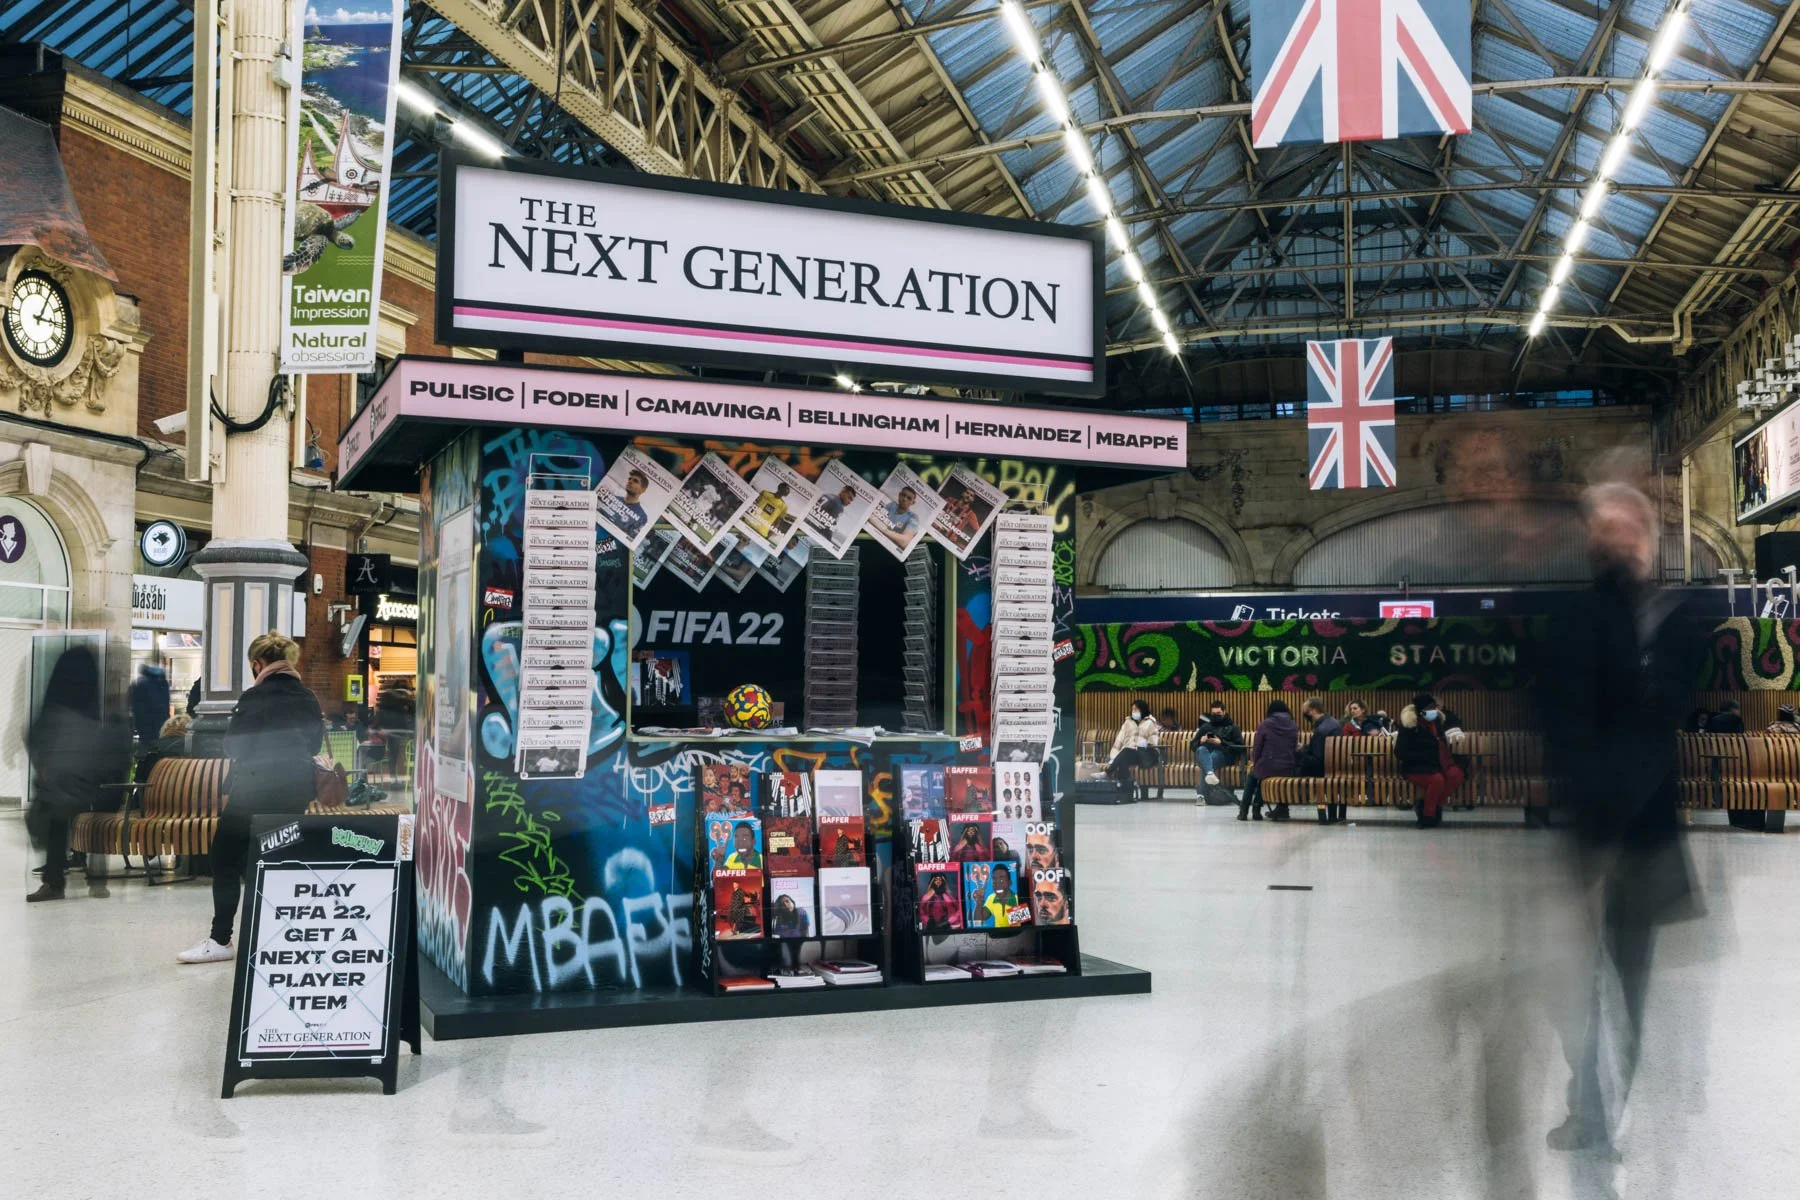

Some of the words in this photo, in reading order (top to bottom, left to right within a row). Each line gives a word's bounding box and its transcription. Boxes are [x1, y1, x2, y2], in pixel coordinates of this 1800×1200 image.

[520, 197, 597, 227] THE
[488, 222, 668, 284] NEXT
[683, 246, 1060, 324] GENERATION
[293, 284, 370, 304] Taiwan
[293, 306, 368, 321] Impression
[292, 332, 366, 348] Natural
[292, 350, 364, 361] obsession
[410, 380, 514, 402] PULISIC
[533, 390, 618, 410] FODEN
[636, 397, 782, 422] CAMAVINGA
[798, 409, 940, 433] BELLINGHAM
[956, 422, 1082, 444] HERNÁNDEZ
[1096, 432, 1178, 450] MBAPPÉ
[638, 462, 674, 490] GENERATION
[716, 470, 751, 500] GENERATION
[780, 472, 814, 499] GENERATION
[842, 475, 876, 502] GENERATION
[908, 480, 939, 508] GENERATION
[966, 479, 999, 504] GENERATION
[597, 487, 642, 521] CHRISTIAN
[356, 556, 378, 584] A
[132, 588, 166, 610] wasabi
[1266, 608, 1341, 619] Tickets
[646, 610, 732, 644] FIFA
[736, 612, 784, 644] 22
[1218, 645, 1348, 667] VICTORIA
[1390, 643, 1516, 666] STATION
[260, 824, 300, 852] PULISIC
[1026, 824, 1054, 835] OOF
[1034, 870, 1064, 882] OOF
[294, 884, 356, 897] PLAY
[275, 906, 327, 920] FIFA
[333, 906, 371, 921] 22,
[284, 928, 335, 942] GET
[340, 928, 357, 941] A
[260, 950, 324, 965] NEXT
[332, 950, 384, 964] GEN
[268, 972, 366, 988] PLAYER
[289, 996, 347, 1010] ITEM
[258, 1033, 291, 1042] NEXT
[294, 1032, 371, 1042] GENERATION
